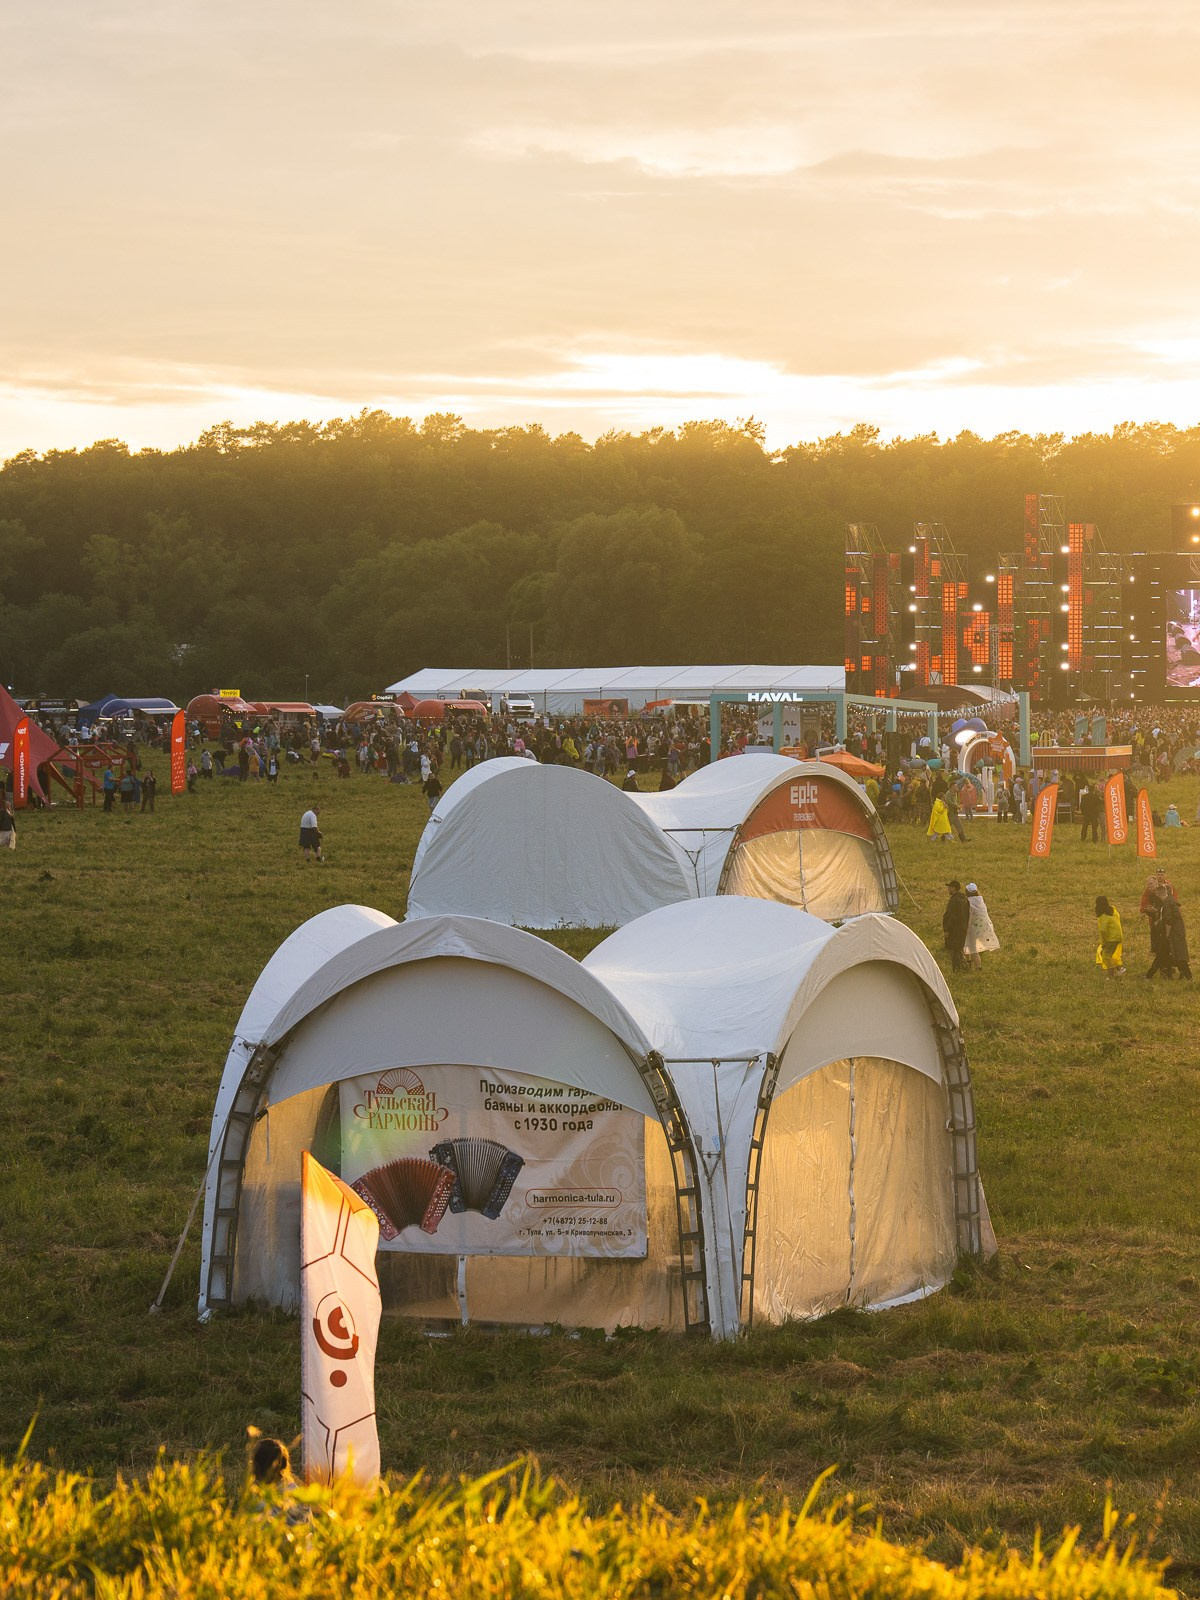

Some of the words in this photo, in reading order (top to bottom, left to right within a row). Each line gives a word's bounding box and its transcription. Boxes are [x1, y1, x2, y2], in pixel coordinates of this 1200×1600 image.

[747, 692, 803, 702] HAVAL
[1110, 785, 1121, 829] МУЗТОРГ
[1037, 794, 1050, 841] МУЗТОРГ
[480, 1080, 563, 1098] Производим
[568, 1088, 597, 1099] гар
[484, 1098, 523, 1113] баяны
[528, 1103, 536, 1113] и
[539, 1101, 623, 1117] аккордеоны
[367, 1112, 439, 1131] ГАРМОНЬ
[514, 1120, 521, 1130] с
[524, 1117, 558, 1131] 1930
[562, 1120, 594, 1132] года
[533, 1193, 615, 1203] harmonica-tula.ru
